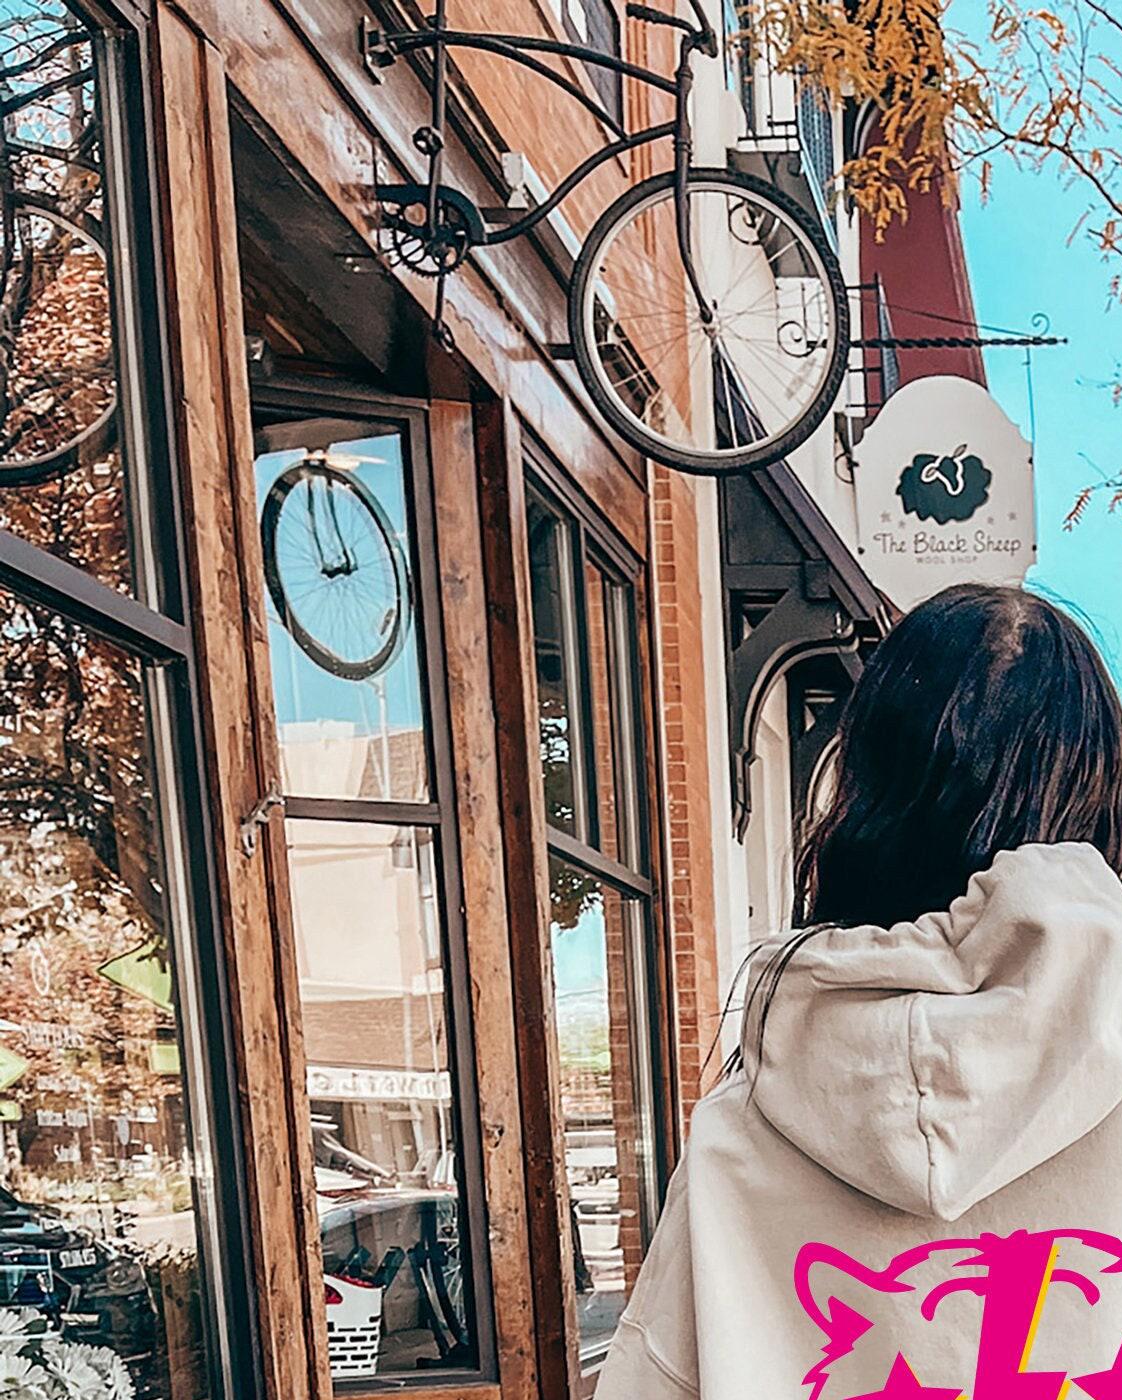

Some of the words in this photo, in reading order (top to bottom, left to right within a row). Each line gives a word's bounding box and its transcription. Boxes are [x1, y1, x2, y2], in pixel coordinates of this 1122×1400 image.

[873, 533, 906, 553] The
[913, 531, 967, 554] Black
[973, 530, 1021, 556] Sheep
[916, 556, 946, 564] WOOL
[951, 556, 978, 564] SHOP
